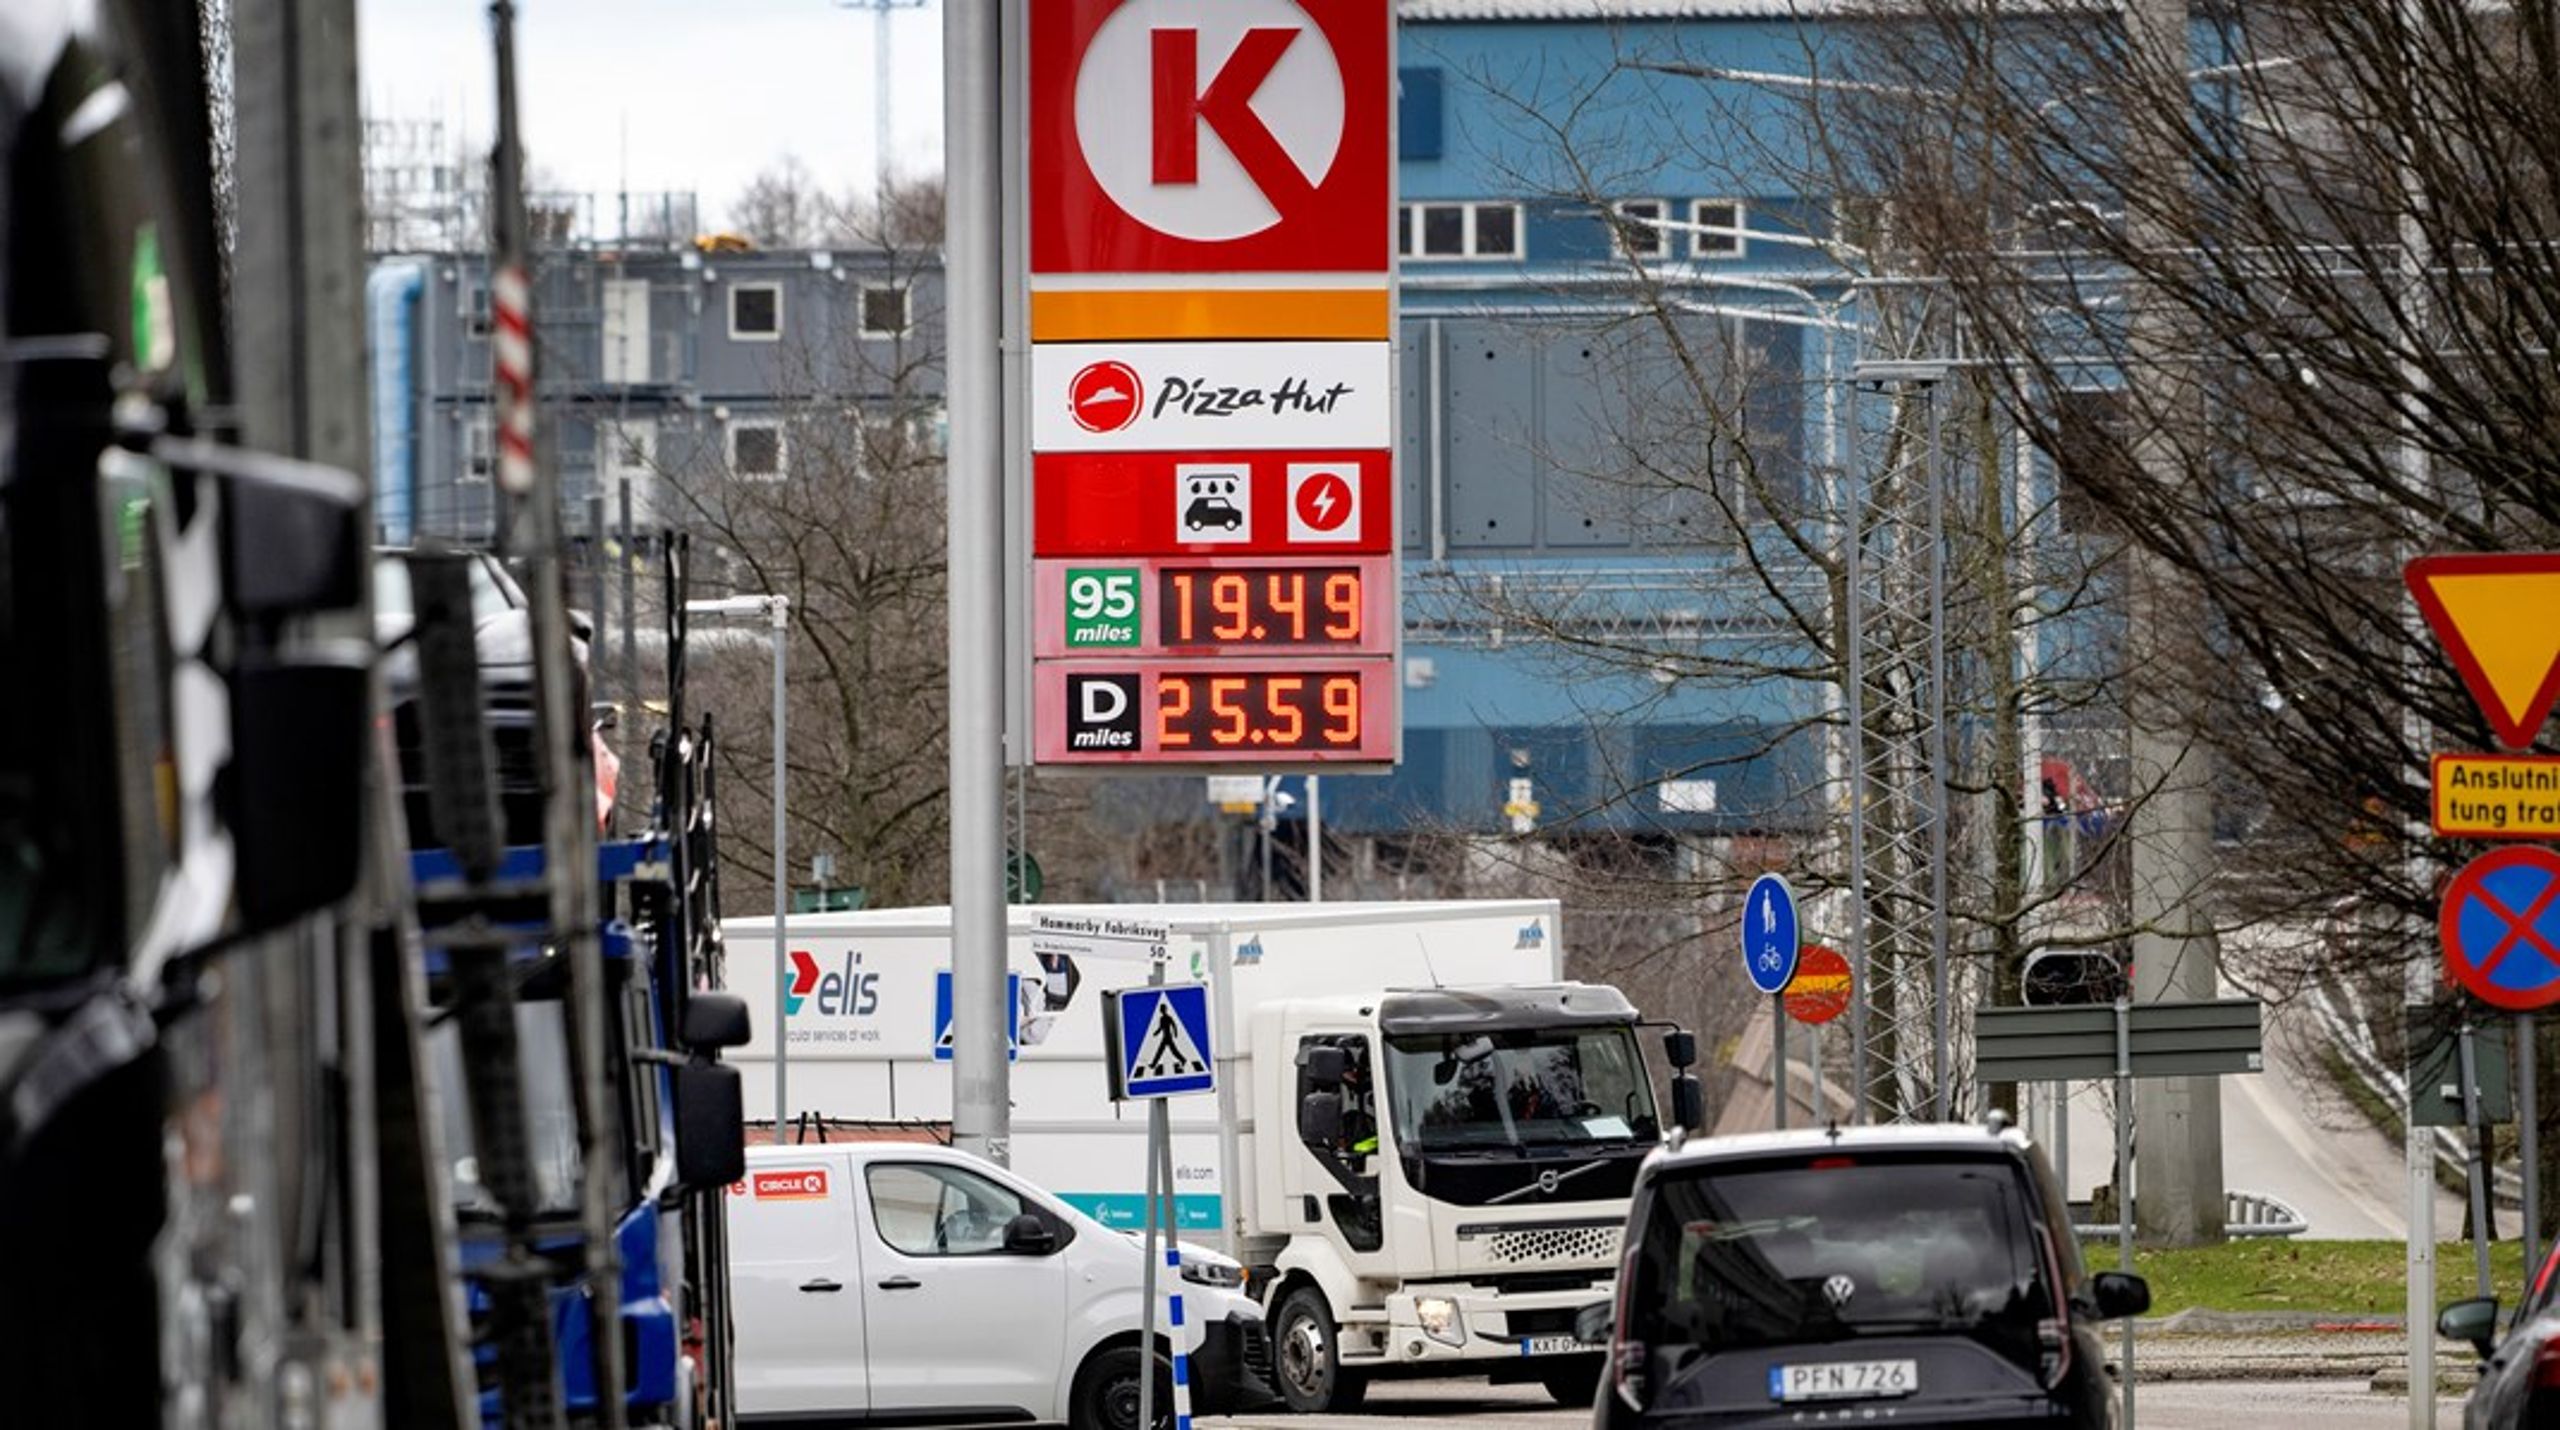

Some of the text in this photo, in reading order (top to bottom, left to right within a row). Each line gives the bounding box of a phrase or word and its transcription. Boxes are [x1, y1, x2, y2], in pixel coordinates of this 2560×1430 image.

[1151, 27, 1316, 222] K
[1152, 376, 1355, 419] Pizza Hut
[1070, 575, 1136, 619] 95
[1173, 573, 1361, 640] 19.49
[1073, 622, 1133, 643] miles
[1080, 680, 1129, 724] D
[1157, 677, 1359, 744] 25.59
[1073, 727, 1133, 748] miles
[2450, 764, 2558, 789] Anslutni
[2450, 798, 2560, 828] tung tra
[1039, 915, 1100, 935] Hammarby
[817, 949, 880, 1016] elis
[1176, 1165, 1214, 1180] elis.com
[1533, 1338, 1558, 1350] KXT
[1793, 1364, 1906, 1391] PFN 726
